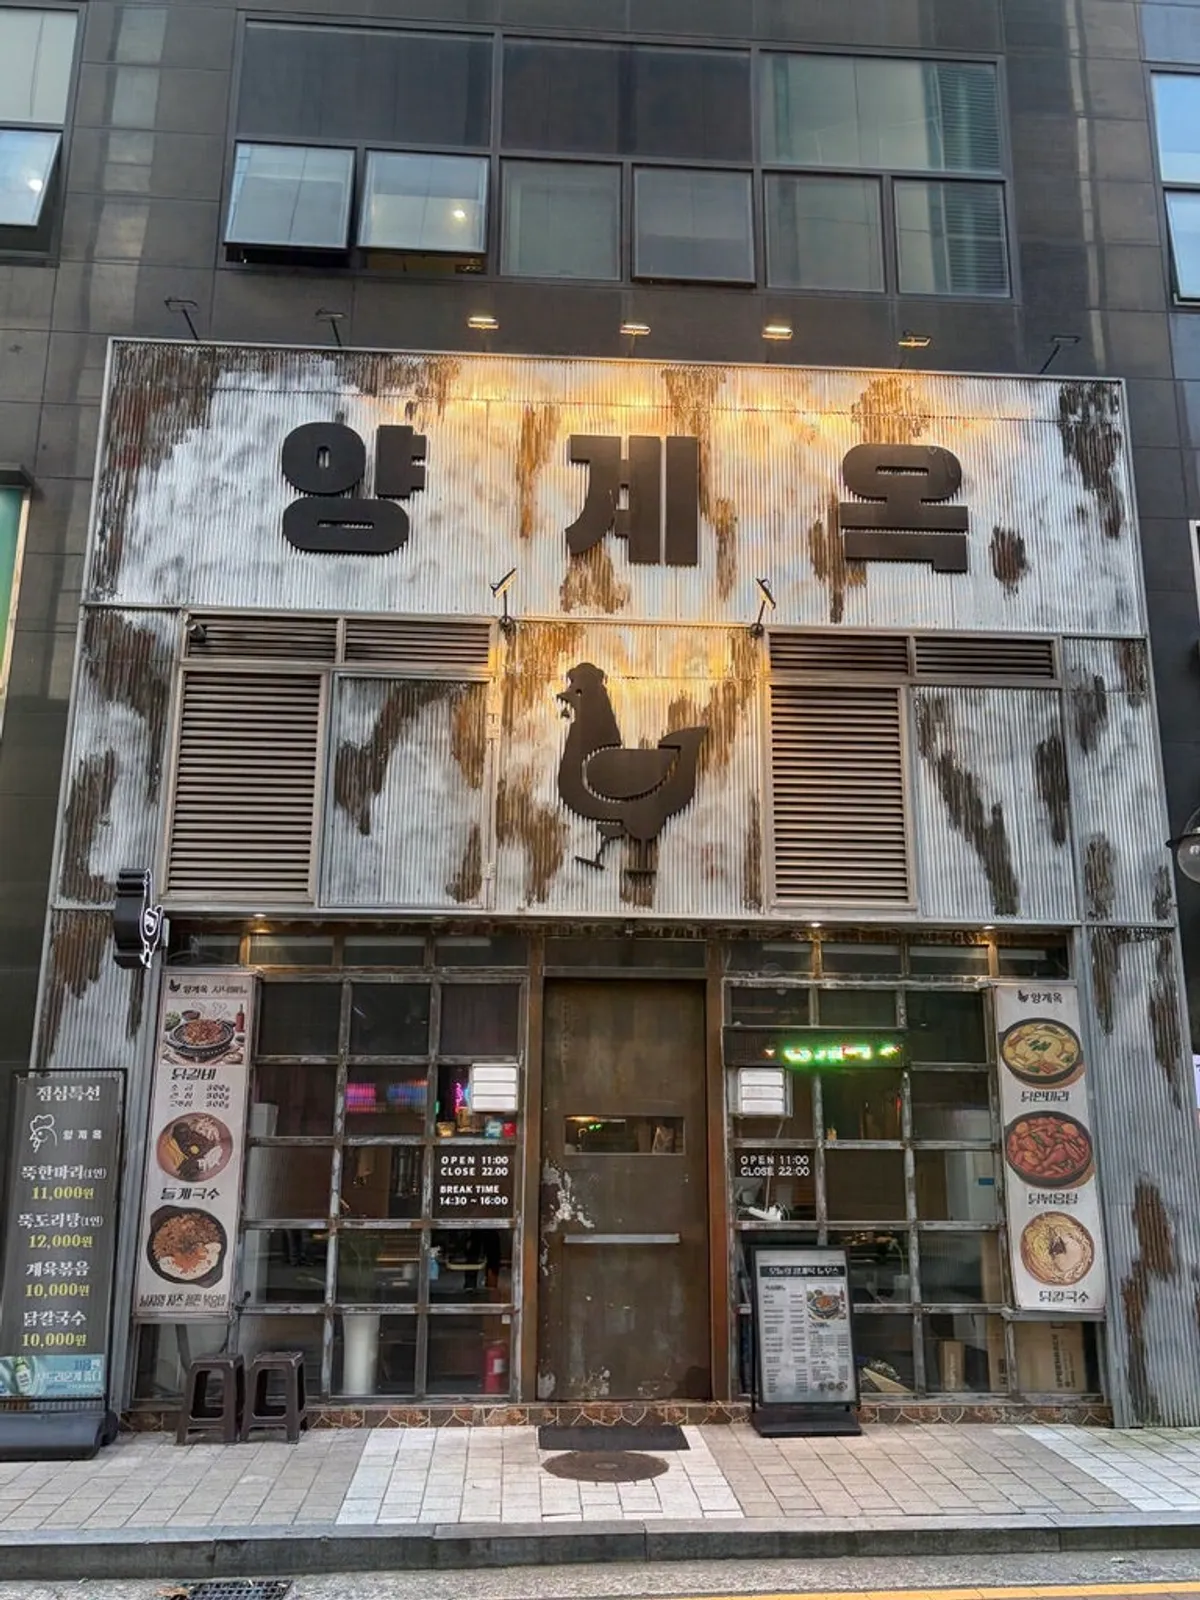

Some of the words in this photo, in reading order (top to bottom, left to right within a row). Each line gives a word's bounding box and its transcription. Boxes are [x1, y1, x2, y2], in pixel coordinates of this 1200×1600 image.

[282, 422, 967, 573] 양계옥
[1031, 992, 1063, 1004] 양계옥
[171, 1068, 217, 1080] 닭갈비
[36, 1085, 101, 1102] 점심특선
[1020, 1090, 1070, 1103] 닭한마리
[440, 1155, 476, 1166] OPEN
[481, 1155, 509, 1166] 11:00
[740, 1154, 775, 1166] OPEN
[779, 1154, 810, 1166] 11:00
[440, 1166, 476, 1177] CLOSE
[740, 1165, 775, 1177] CLOSE
[778, 1165, 811, 1177] 22:00
[31, 1185, 94, 1201] 11,000원
[440, 1184, 473, 1194] BREAK
[475, 1184, 500, 1194] TIME
[439, 1195, 468, 1206] 14:30
[480, 1195, 509, 1206] 16:00
[1028, 1192, 1078, 1205] 닭볶음탕
[28, 1233, 94, 1250] 12,000원
[25, 1282, 91, 1299] 10,000원
[23, 1309, 88, 1327] 닭칼국수
[21, 1331, 88, 1348] 10,000원
